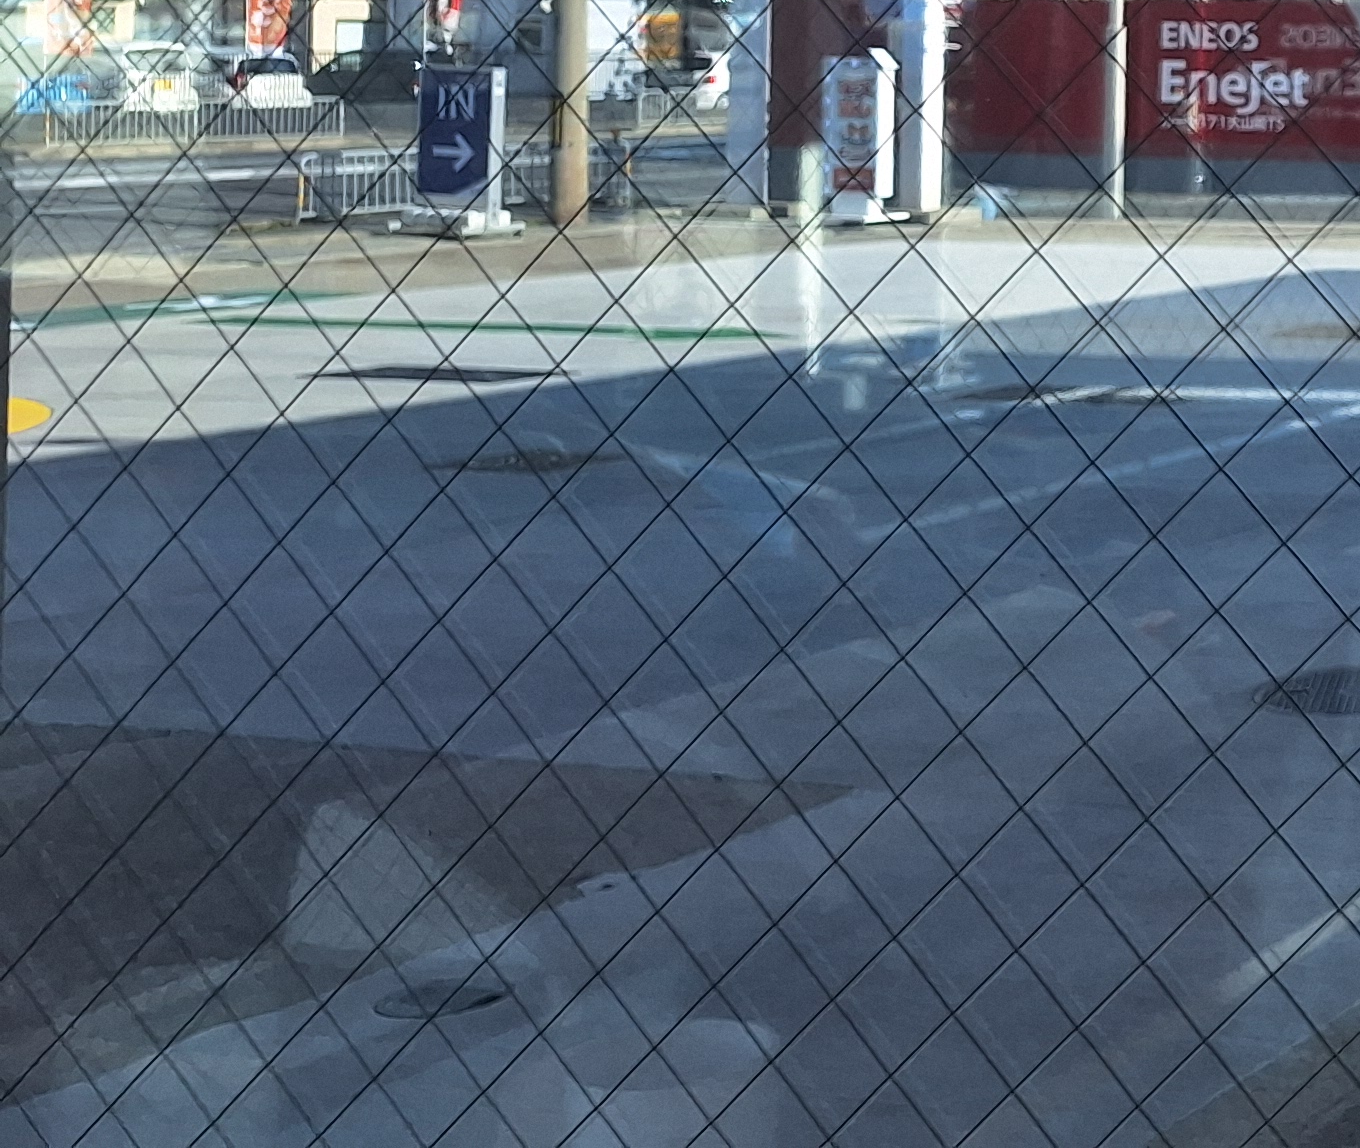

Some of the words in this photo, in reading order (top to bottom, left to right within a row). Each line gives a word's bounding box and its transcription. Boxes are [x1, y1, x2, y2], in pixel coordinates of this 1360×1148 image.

[1160, 21, 1259, 51] ENEOS
[437, 84, 477, 121] IN
[1160, 59, 1310, 115] EneJet
